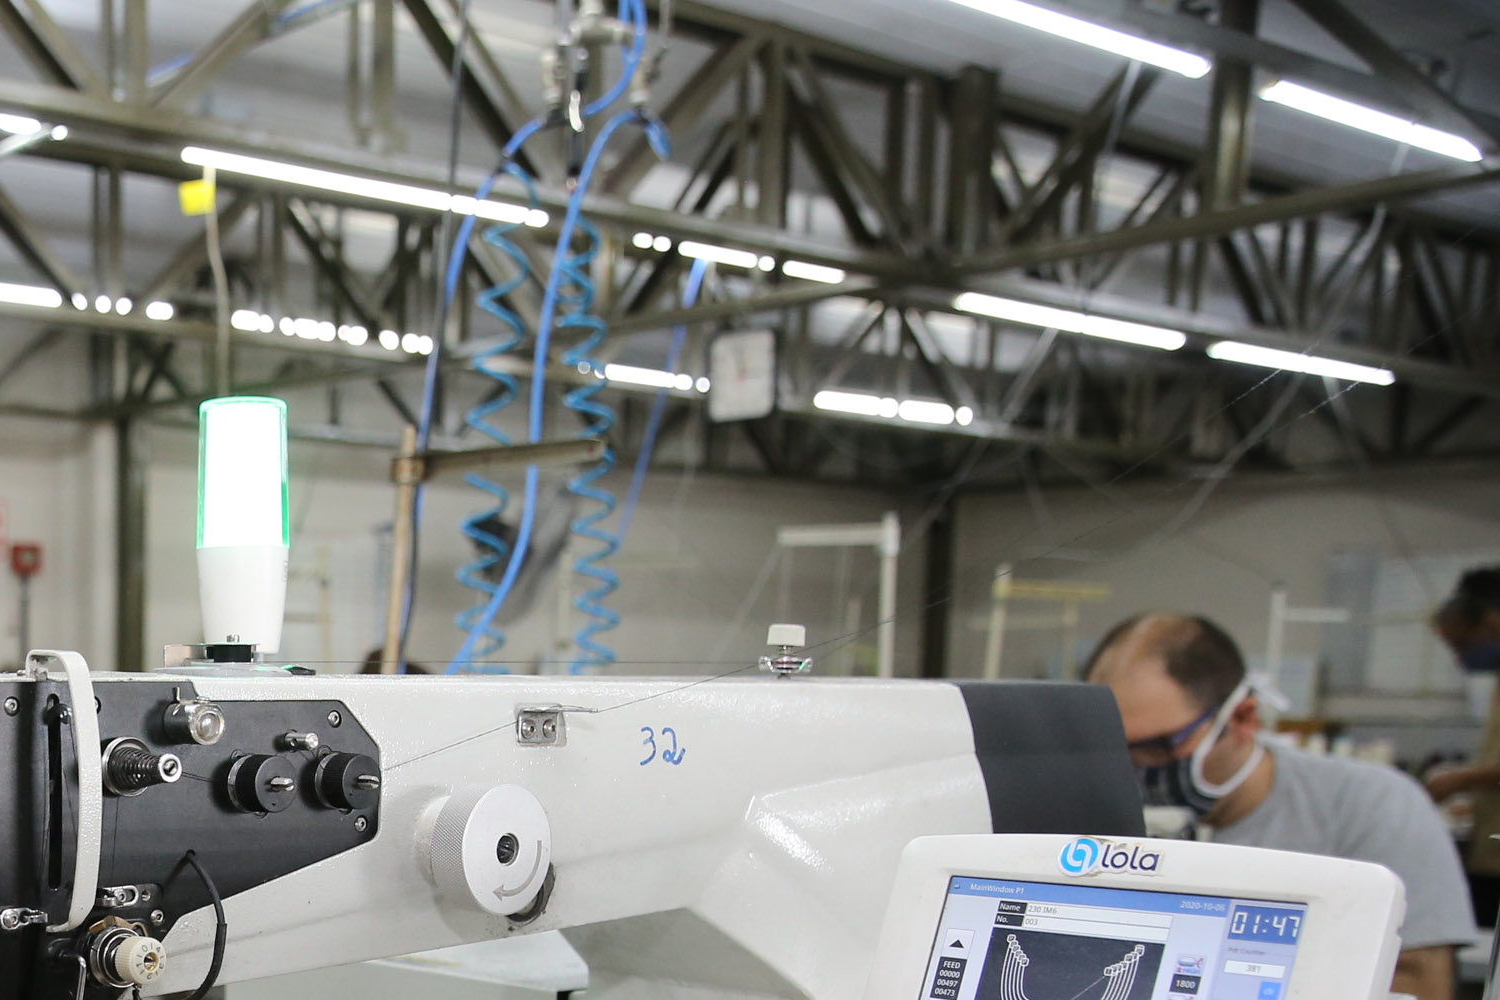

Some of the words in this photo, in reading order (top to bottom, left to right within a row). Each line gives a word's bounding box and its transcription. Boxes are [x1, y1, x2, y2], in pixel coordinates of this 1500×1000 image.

[640, 726, 686, 766] 32
[1101, 844, 1160, 871] lola
[970, 883, 1015, 894] MainWindow
[999, 902, 1021, 912] Name
[1028, 905, 1042, 913] 230
[1180, 901, 1226, 912] 2020-10-06
[996, 915, 1008, 924] No.
[1024, 918, 1038, 926] 003
[1231, 911, 1300, 938] 01:47
[943, 960, 961, 969] FEED
[939, 969, 960, 978] 00000
[936, 978, 958, 987] 00497
[1175, 980, 1196, 989] 1800
[934, 987, 955, 996] 00473
